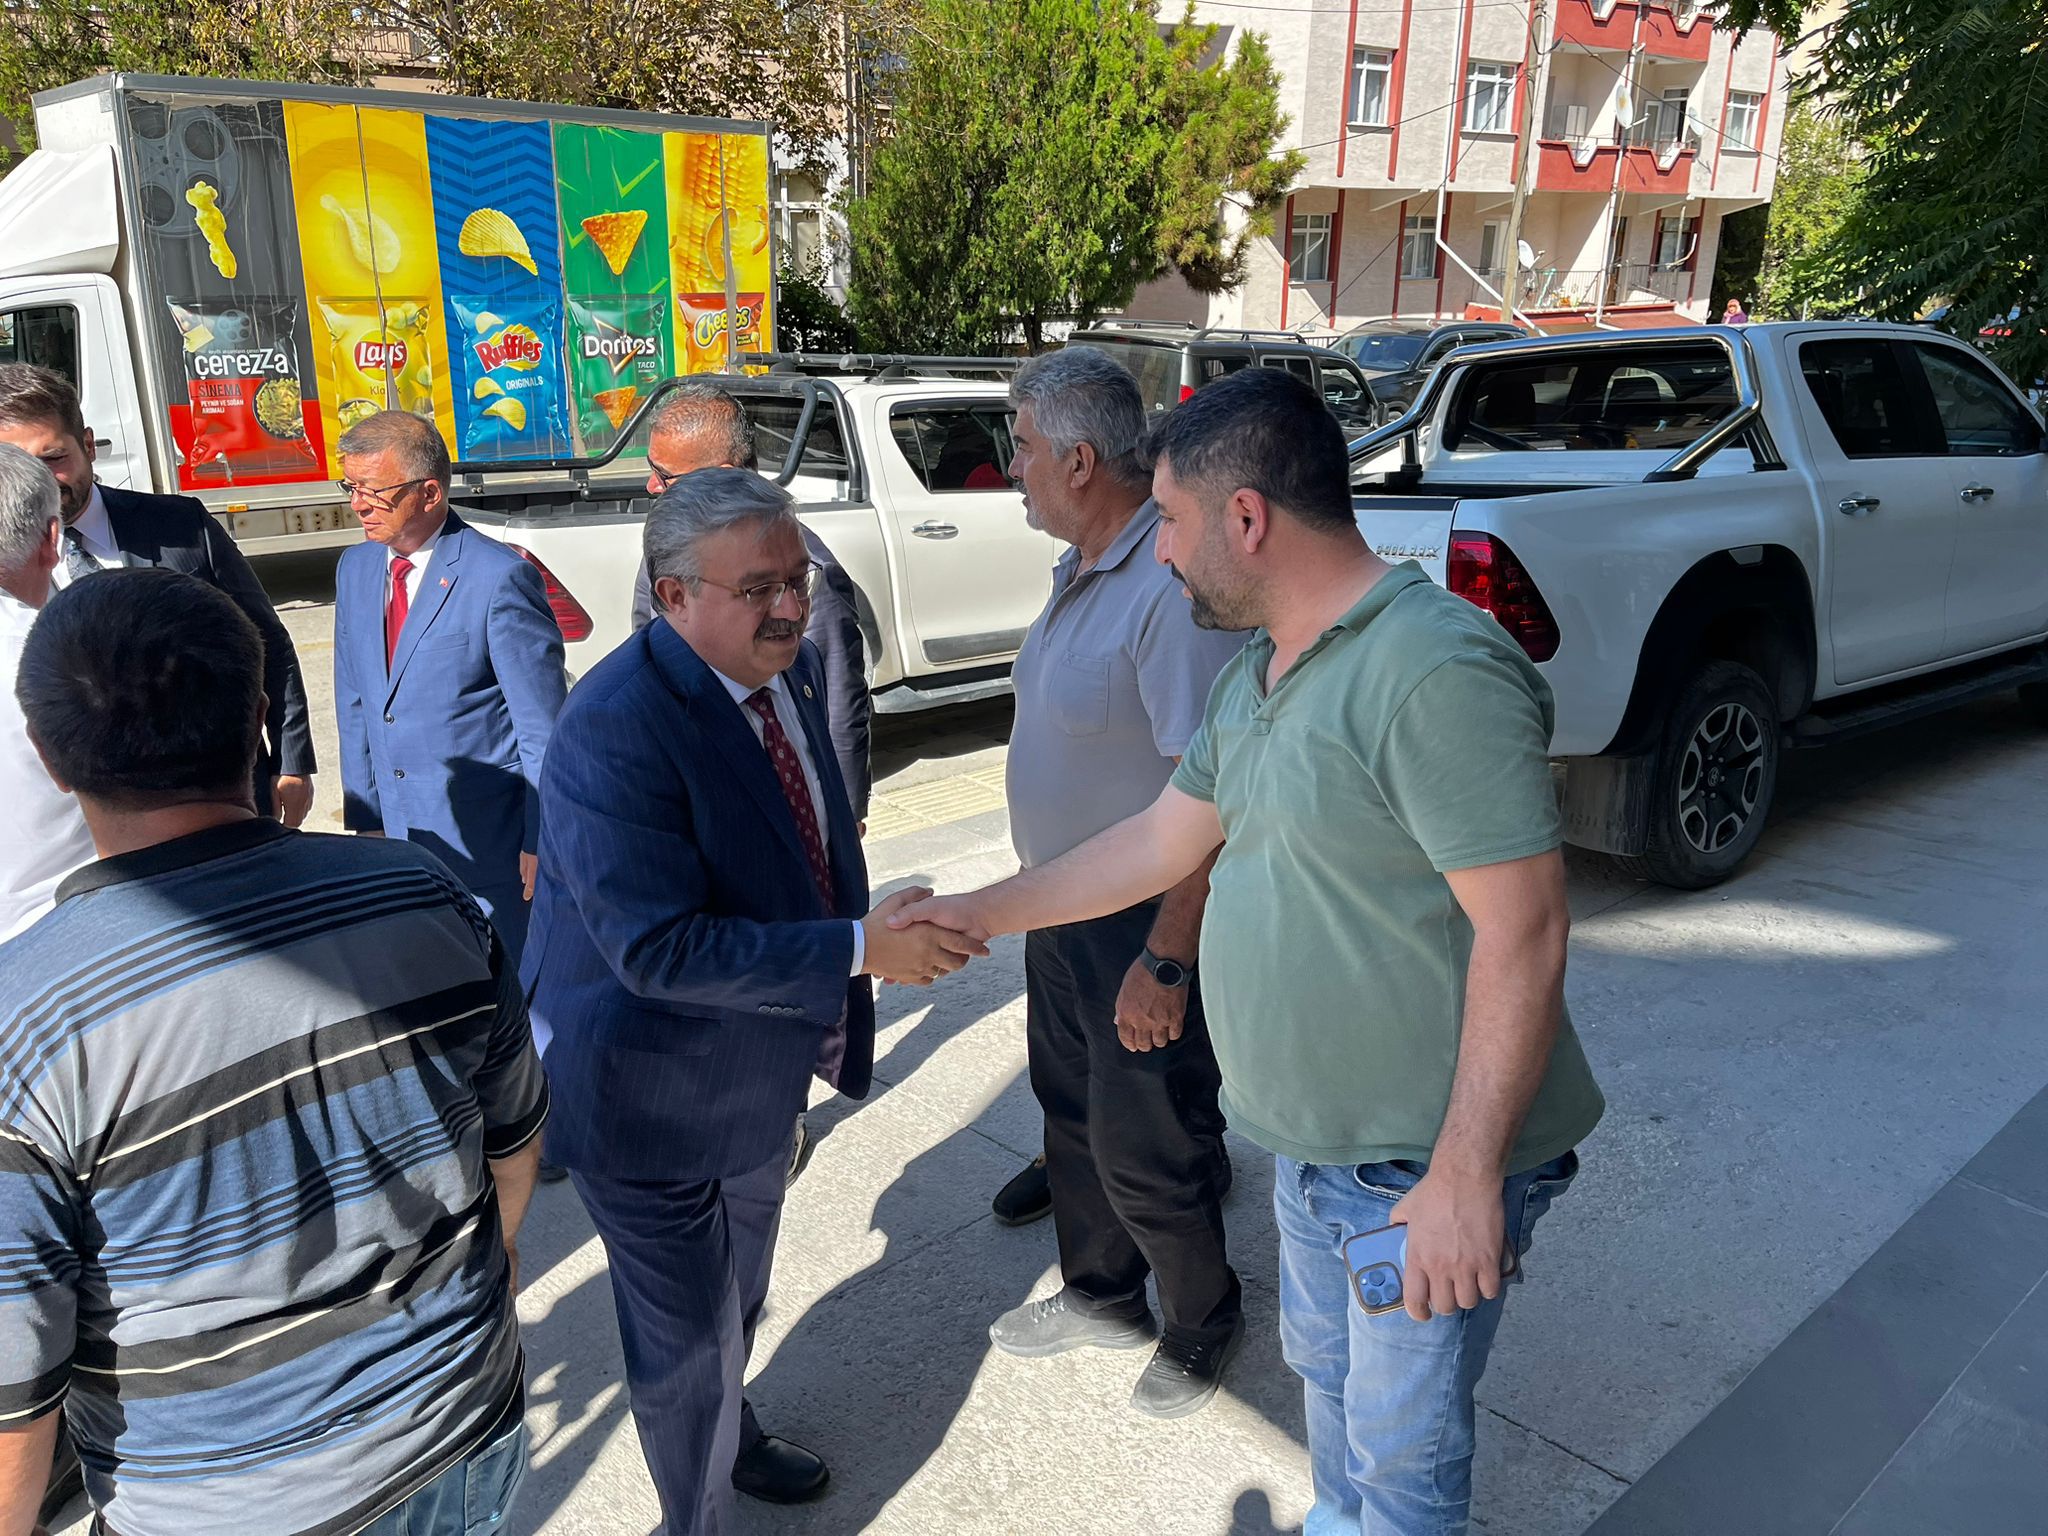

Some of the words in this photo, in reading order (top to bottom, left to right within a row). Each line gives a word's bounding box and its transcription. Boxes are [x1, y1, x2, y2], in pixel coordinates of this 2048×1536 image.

[695, 306, 751, 348] Cheeos
[474, 333, 543, 372] Ruffles
[584, 334, 656, 356] Doritos
[198, 382, 242, 397] SİNEMA
[505, 375, 544, 390] ORIGINALS
